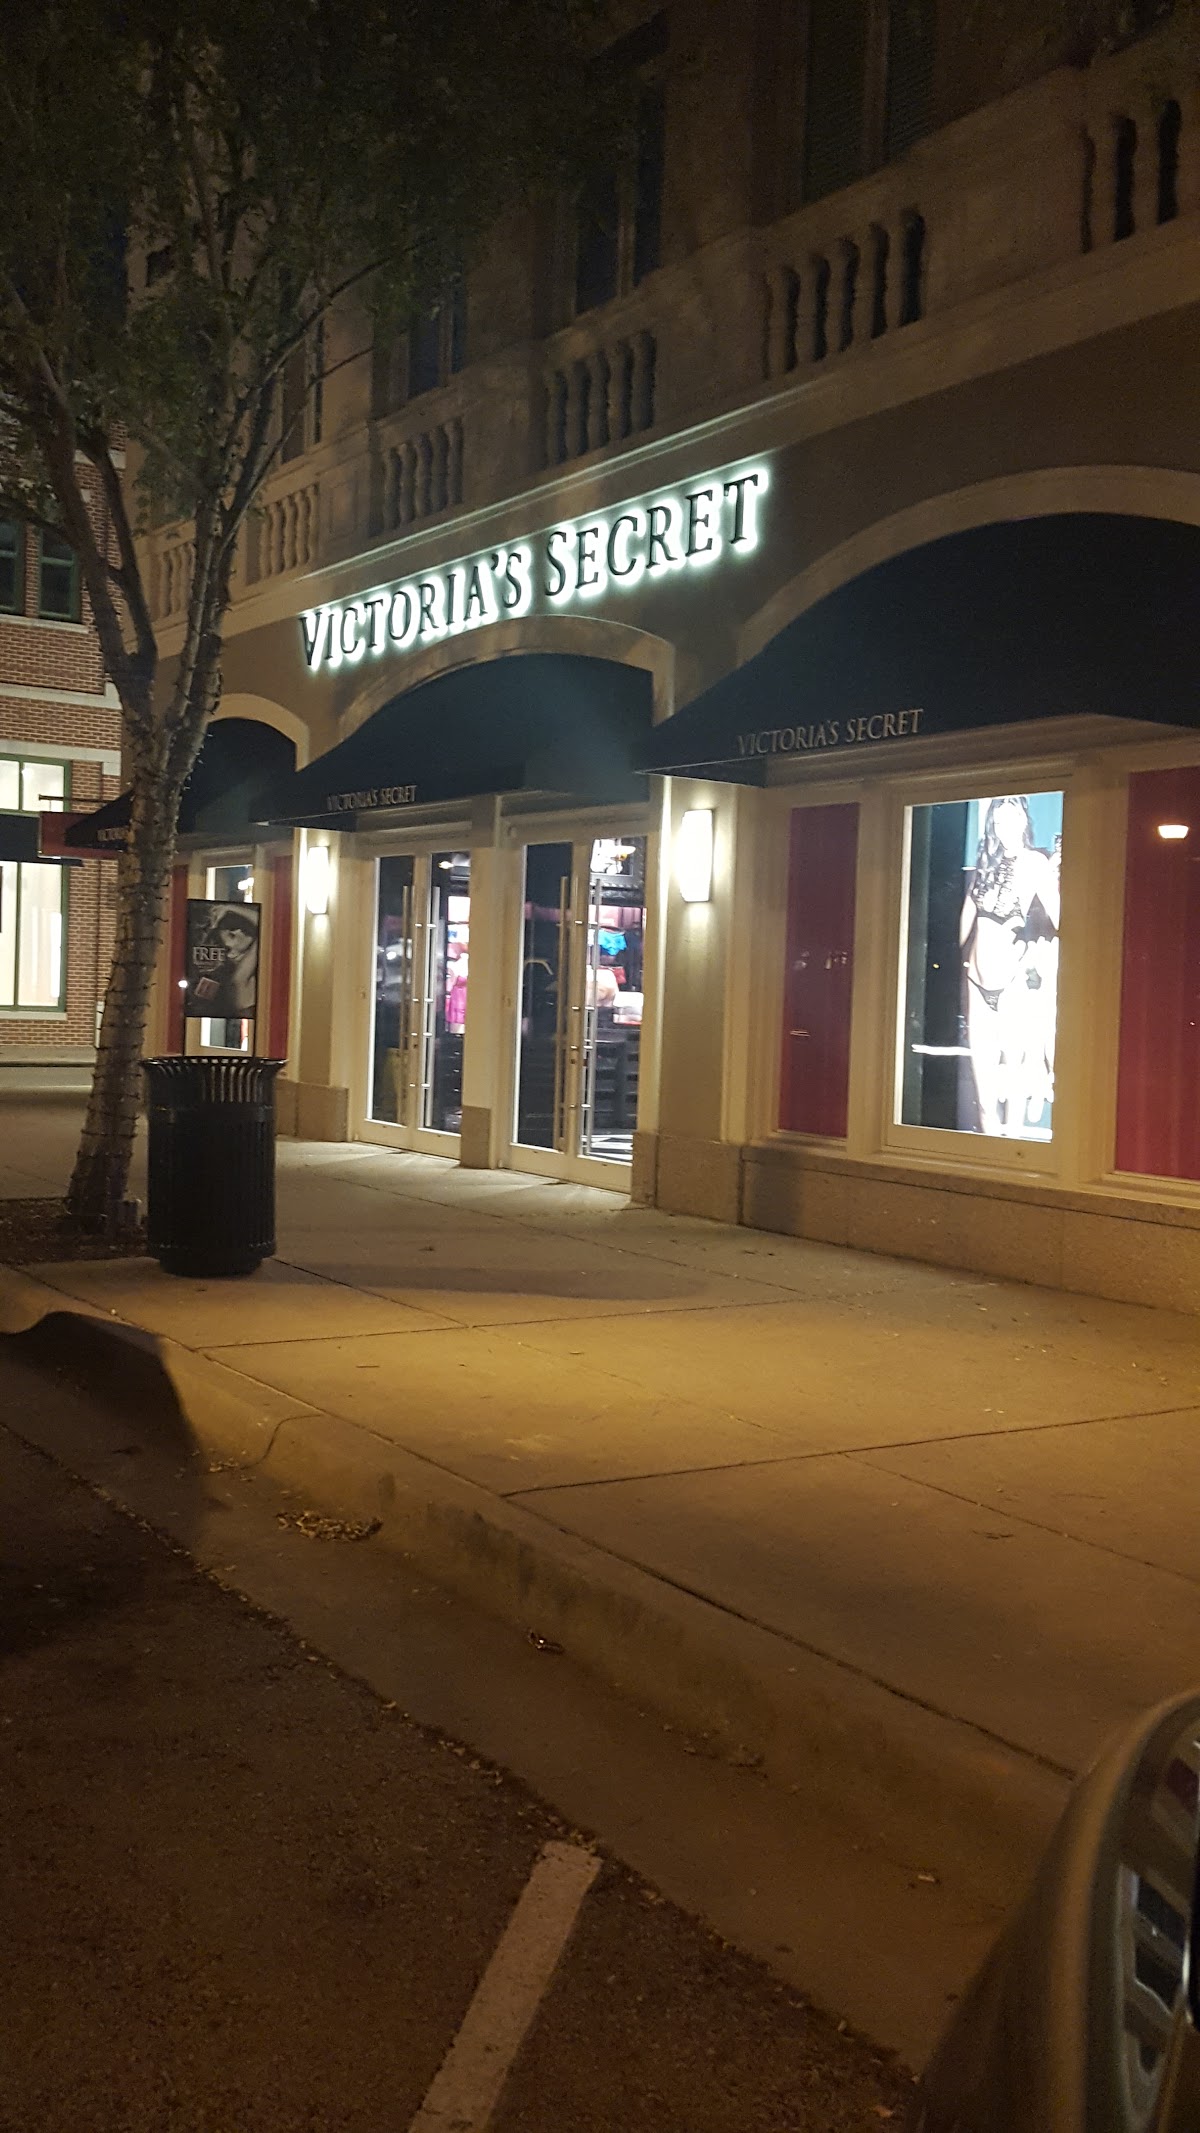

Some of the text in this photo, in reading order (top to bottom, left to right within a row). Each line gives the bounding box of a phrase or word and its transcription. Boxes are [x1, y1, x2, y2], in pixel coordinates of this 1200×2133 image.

[299, 474, 761, 667] VICTORIA'S SECRET
[737, 708, 924, 756] VICTORIA'S SECRET
[193, 946, 225, 961] FREE
